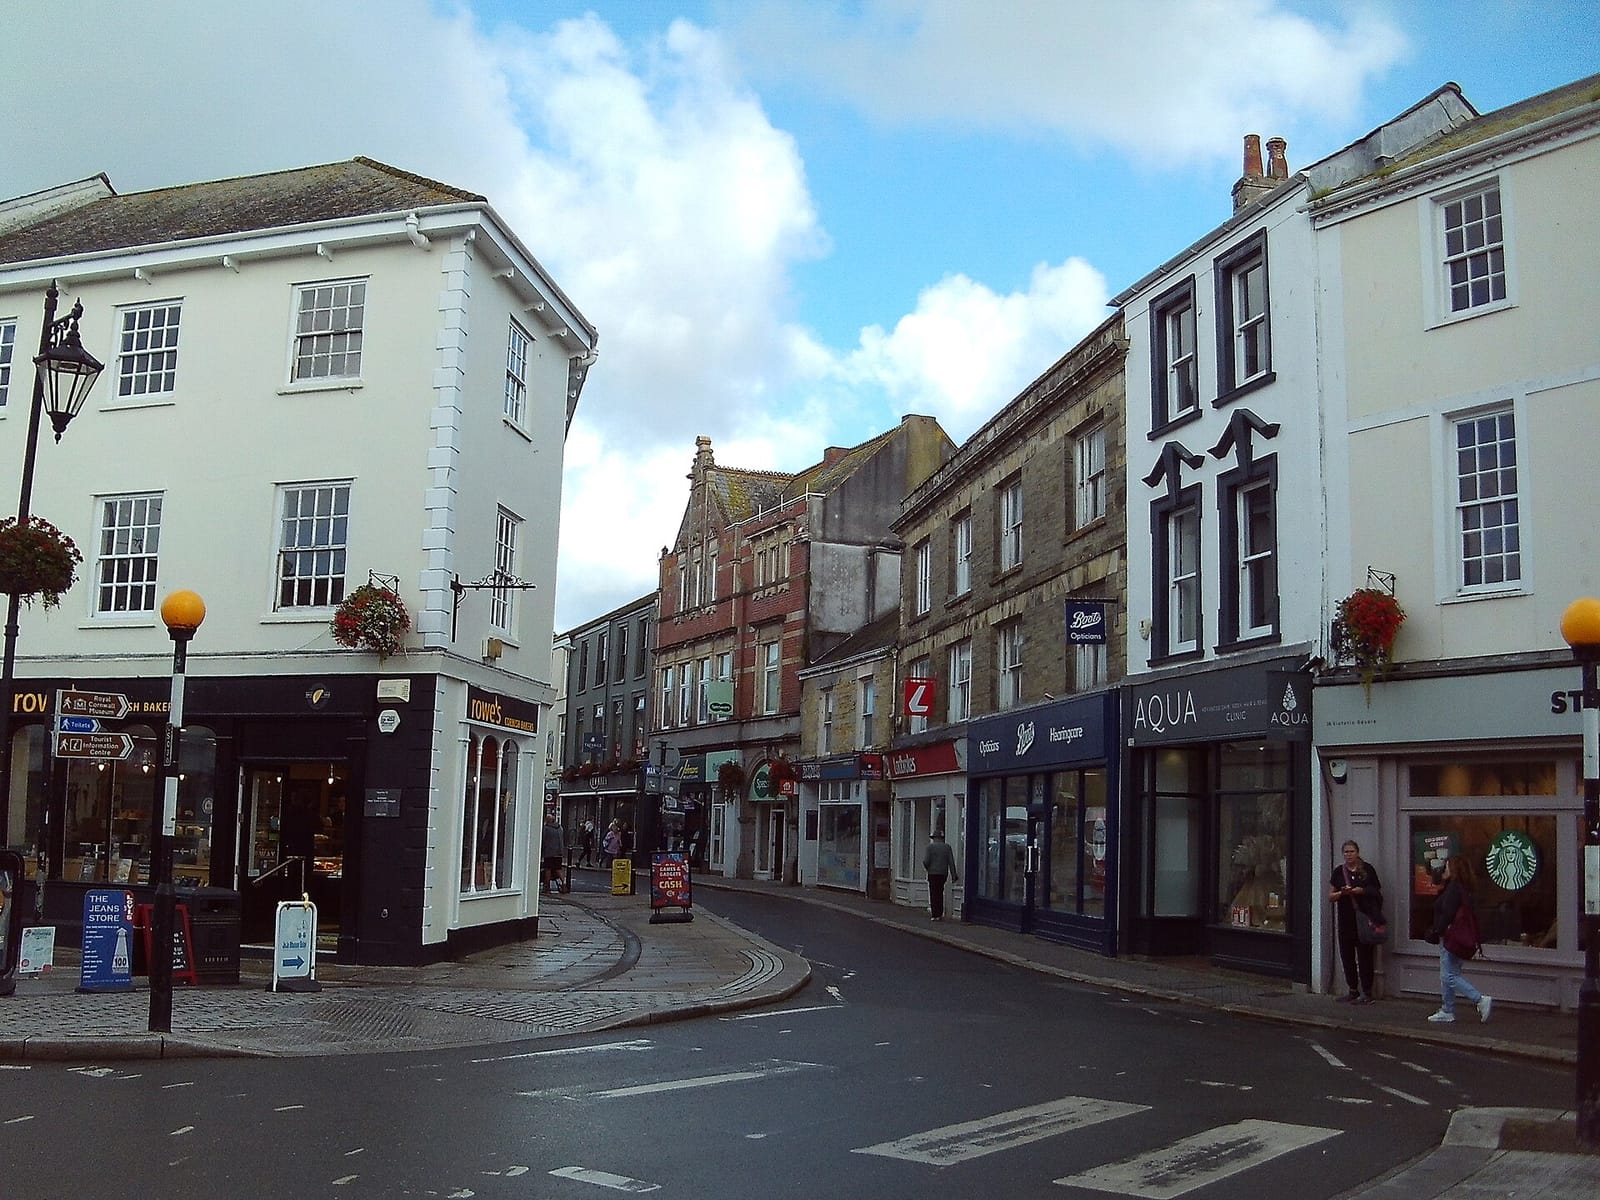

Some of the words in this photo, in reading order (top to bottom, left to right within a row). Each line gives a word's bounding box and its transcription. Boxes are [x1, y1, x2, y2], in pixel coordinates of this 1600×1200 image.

[1070, 611, 1101, 629] Boots
[1070, 632, 1101, 640] Opticians
[88, 701, 115, 709] Cornwall
[472, 695, 502, 724] rowe's
[1134, 690, 1197, 733] AQUA
[1270, 712, 1309, 726] AQUA
[71, 721, 91, 729] Toilets
[1016, 721, 1035, 756] Boots
[1049, 726, 1083, 744] Hearingcare
[659, 880, 682, 889] CASH
[89, 895, 108, 903] THE
[88, 904, 120, 912] JEANS
[88, 914, 120, 922] STORE
